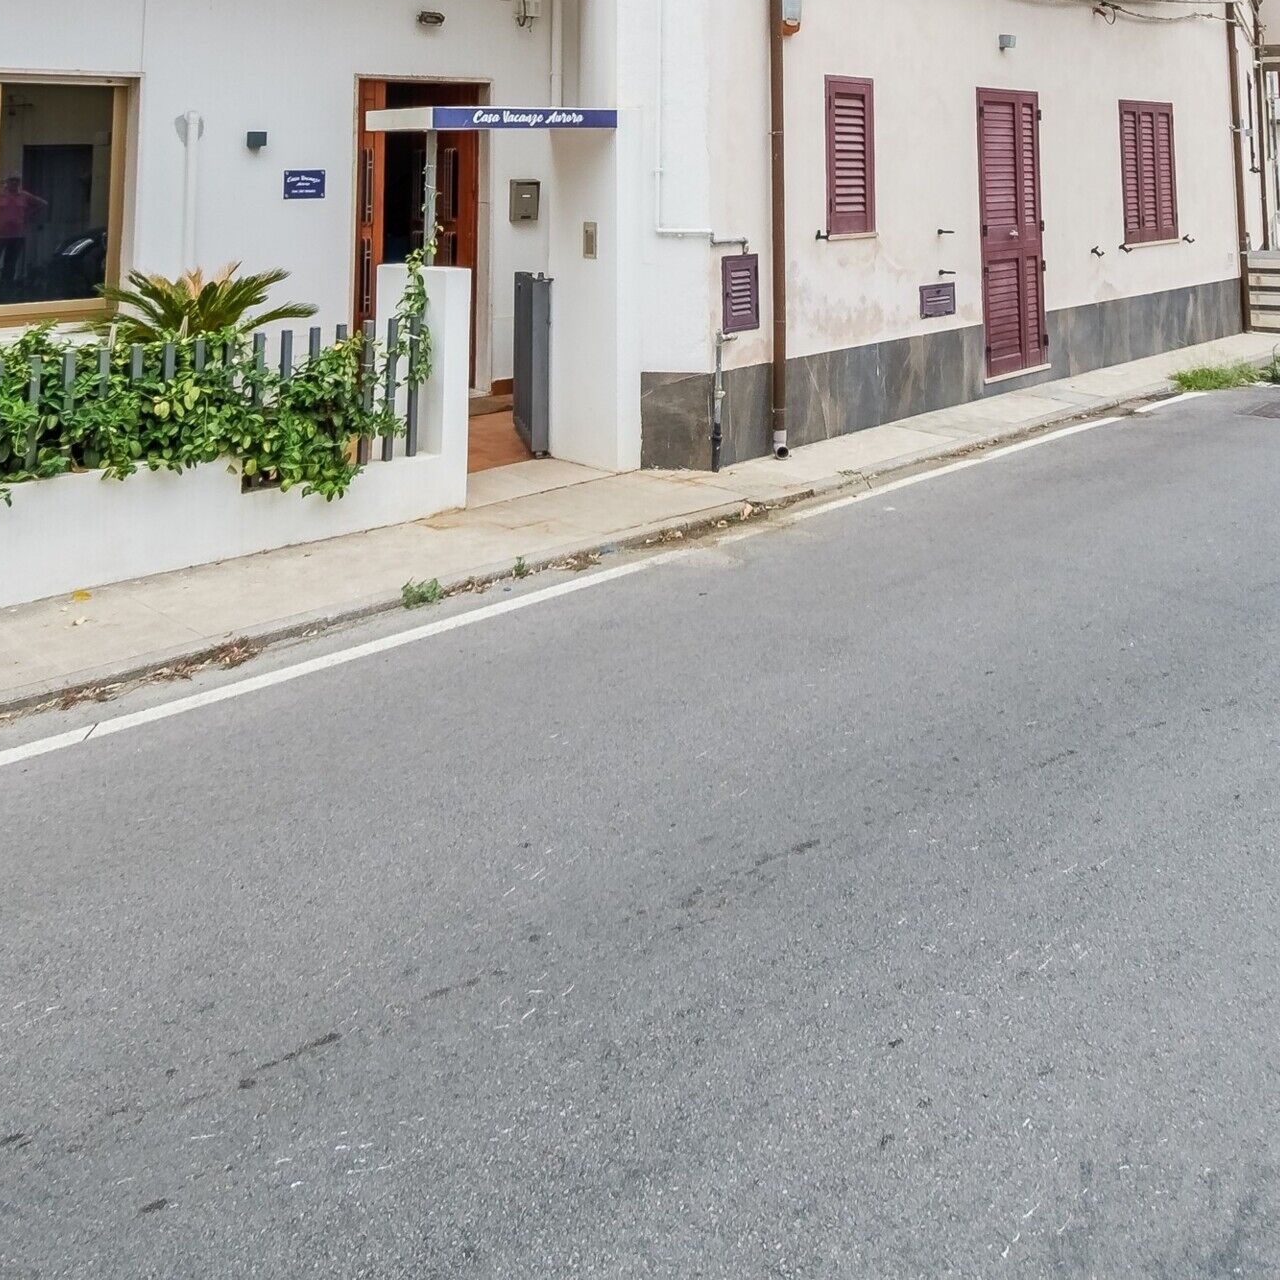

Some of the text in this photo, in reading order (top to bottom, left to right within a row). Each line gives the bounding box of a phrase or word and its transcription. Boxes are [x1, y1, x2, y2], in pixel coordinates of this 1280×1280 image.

[473, 109, 585, 127] Casa Vacanze Aurora
